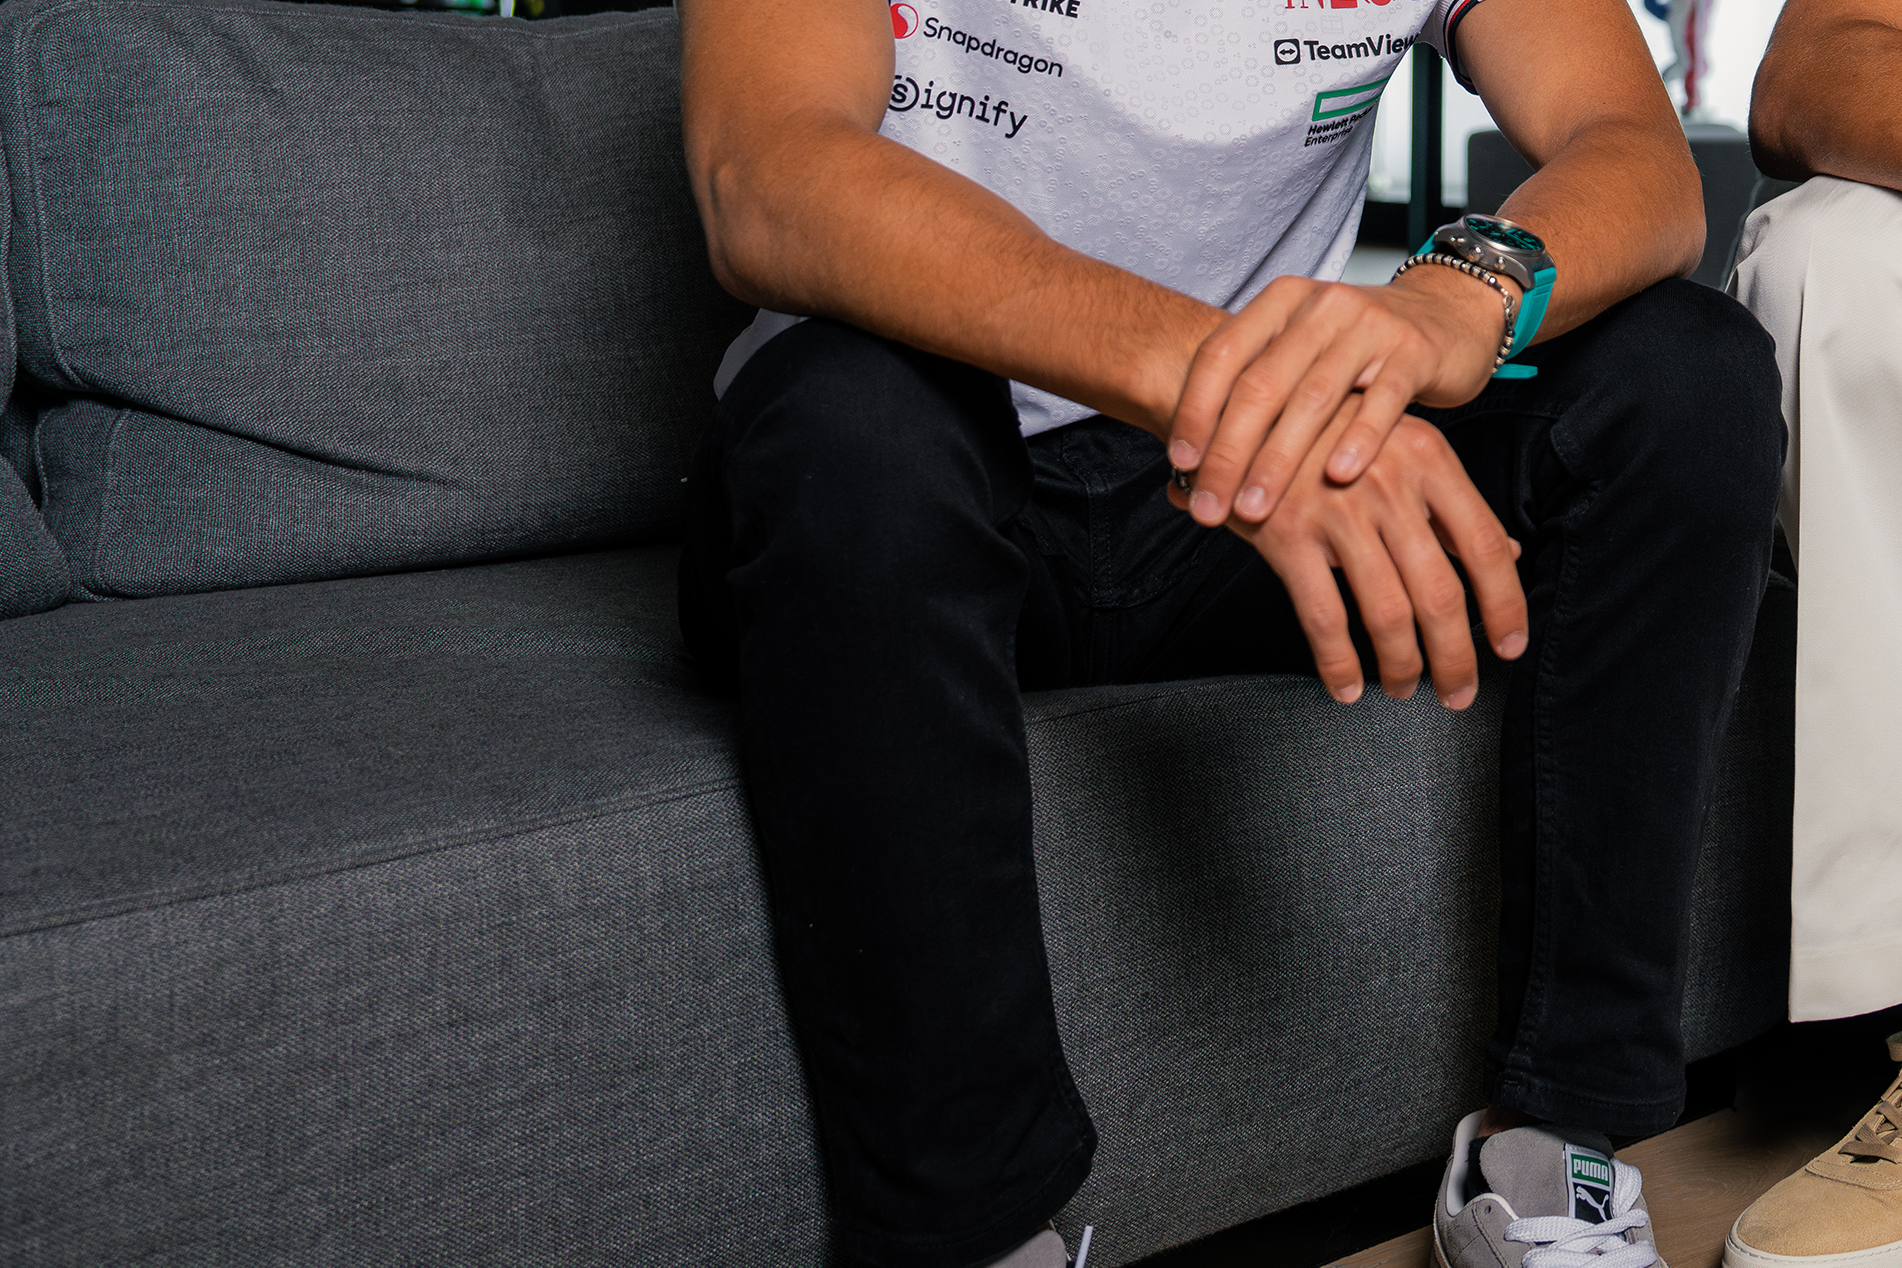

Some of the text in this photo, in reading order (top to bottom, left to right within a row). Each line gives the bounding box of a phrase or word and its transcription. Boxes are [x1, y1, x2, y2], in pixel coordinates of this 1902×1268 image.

[923, 16, 1064, 78] Snapdragon
[1304, 33, 1419, 61] TeamView
[1308, 117, 1350, 136] Hewlett
[1574, 1159, 1609, 1182] PUMA
